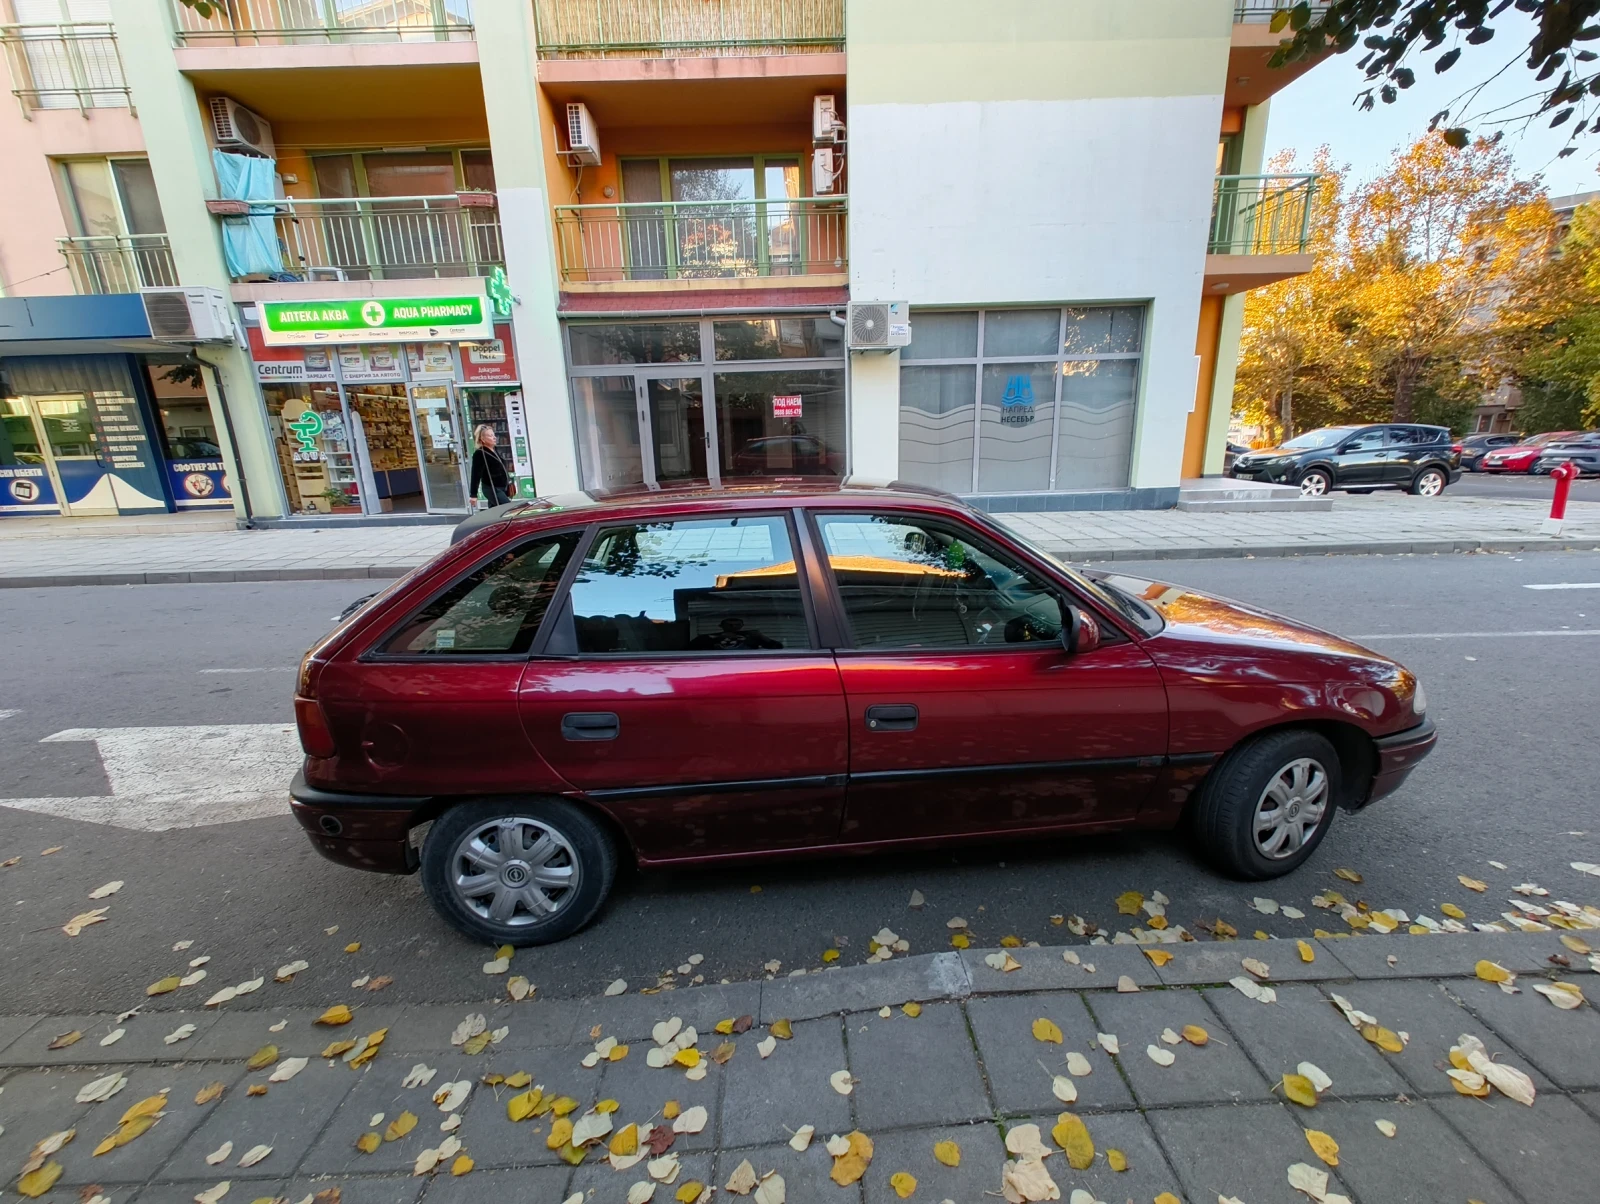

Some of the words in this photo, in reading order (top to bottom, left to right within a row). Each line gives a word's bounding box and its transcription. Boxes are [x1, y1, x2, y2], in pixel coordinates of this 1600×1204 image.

[280, 311, 320, 323] АПТЕКА
[322, 309, 349, 321] АКВА
[394, 307, 419, 319] AQUA
[421, 304, 473, 318] PHARMACY
[472, 344, 500, 353] Doppel
[258, 364, 302, 375] Centrum
[774, 398, 786, 407] ПОД
[786, 397, 802, 406] НАЕМ
[293, 452, 328, 461] AQUA
[173, 463, 206, 472] СОФТУЕР
